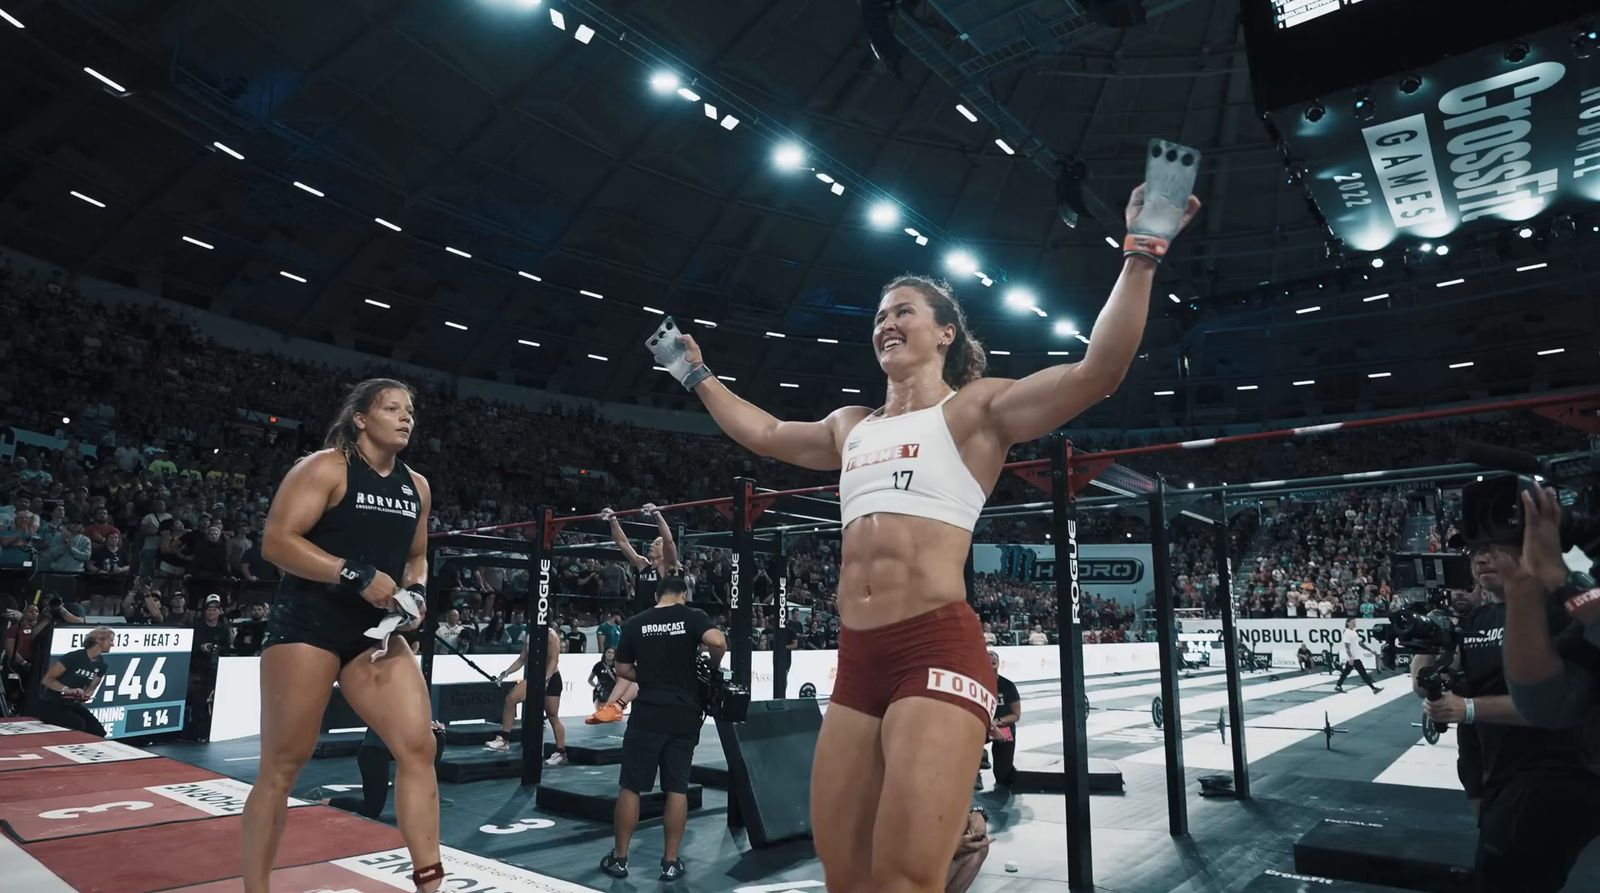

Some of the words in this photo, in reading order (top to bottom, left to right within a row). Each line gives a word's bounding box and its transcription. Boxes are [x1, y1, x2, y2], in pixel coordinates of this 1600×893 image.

[1438, 61, 1566, 222] CrossFit
[1375, 130, 1436, 218] GAMES
[1333, 172, 1372, 207] 2022
[847, 444, 918, 470] TOOMEY
[893, 470, 914, 491] 17
[356, 492, 416, 512] HORVATH
[731, 553, 740, 609] ROGUE
[1036, 564, 1132, 578] HDRO
[1067, 520, 1081, 624] ROGUE
[537, 559, 551, 625] ROGUE
[779, 577, 787, 628] ROGUE
[116, 633, 130, 647] 13
[143, 634, 169, 647] HEAT
[173, 634, 180, 646] 3
[641, 621, 685, 634] BROADCAST
[1239, 629, 1303, 643] NOBULL
[931, 671, 996, 717] TOOME
[38, 800, 154, 819] 3
[479, 817, 556, 834] 3
